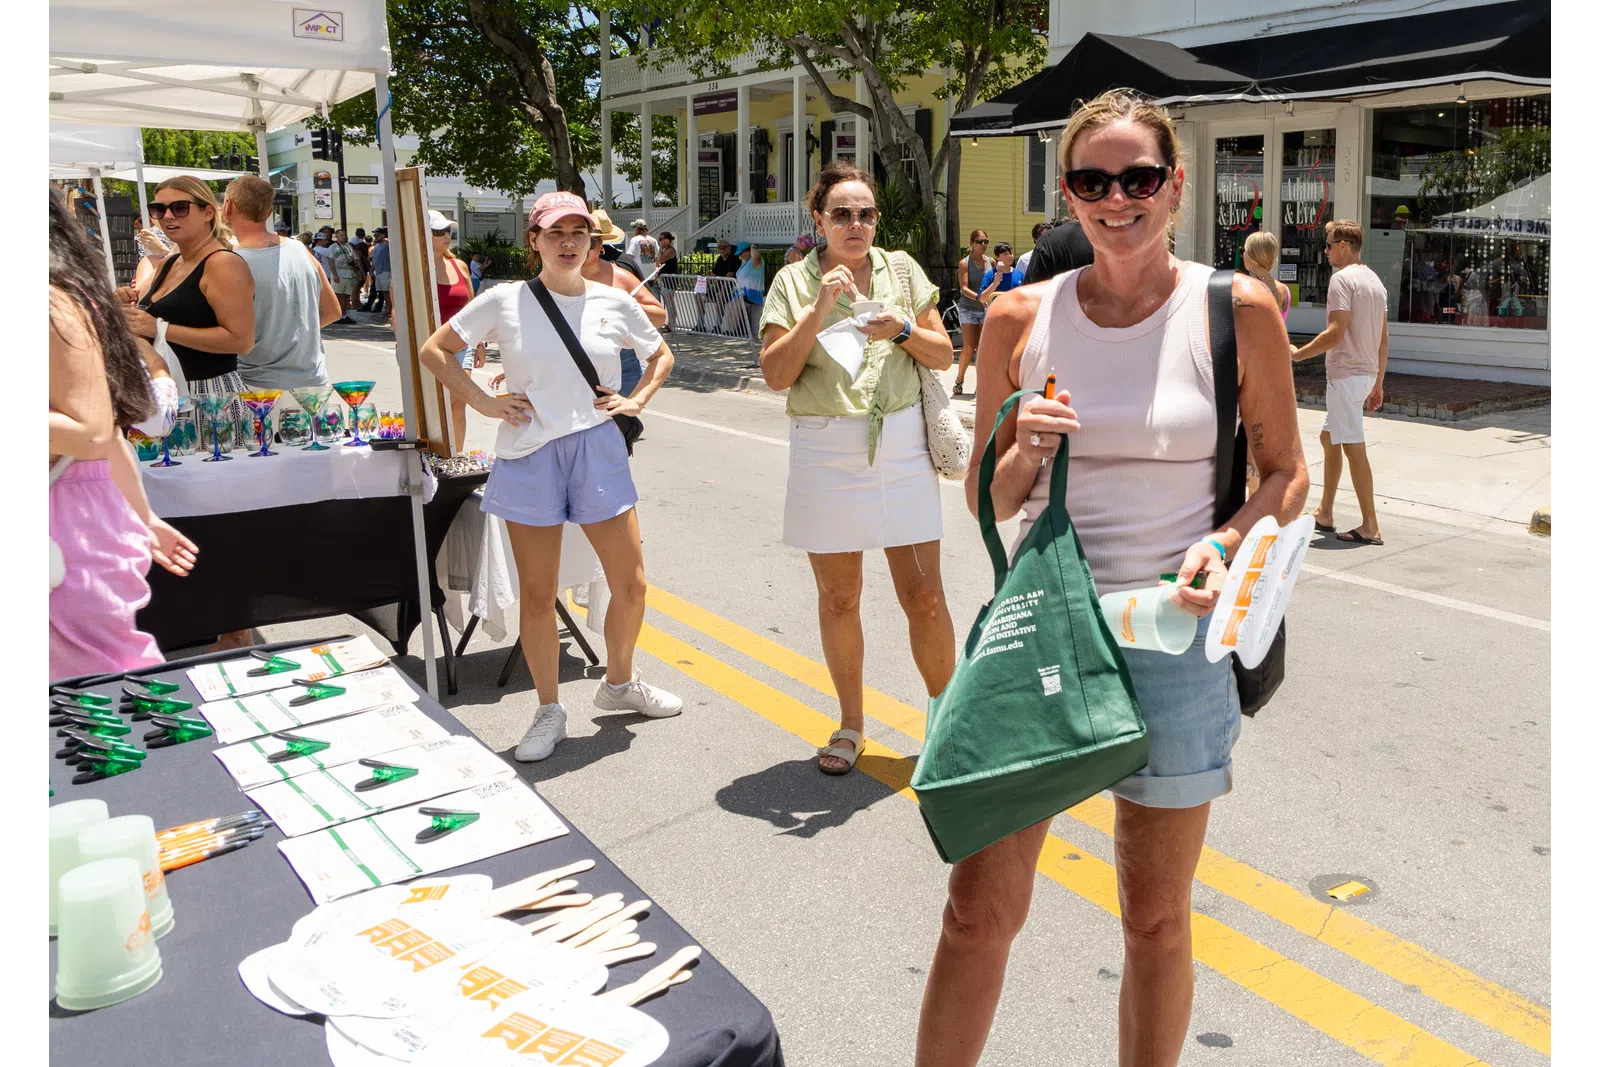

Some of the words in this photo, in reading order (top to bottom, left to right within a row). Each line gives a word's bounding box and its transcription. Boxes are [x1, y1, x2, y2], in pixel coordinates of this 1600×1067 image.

[708, 82, 718, 91] 336
[1220, 180, 1248, 203] Adam
[1287, 177, 1317, 201] Adam
[1218, 203, 1227, 226] &
[1284, 202, 1294, 225] &
[1027, 589, 1045, 600] A&M
[996, 625, 1037, 640] INITIATIVE
[1000, 621, 1018, 631] AND
